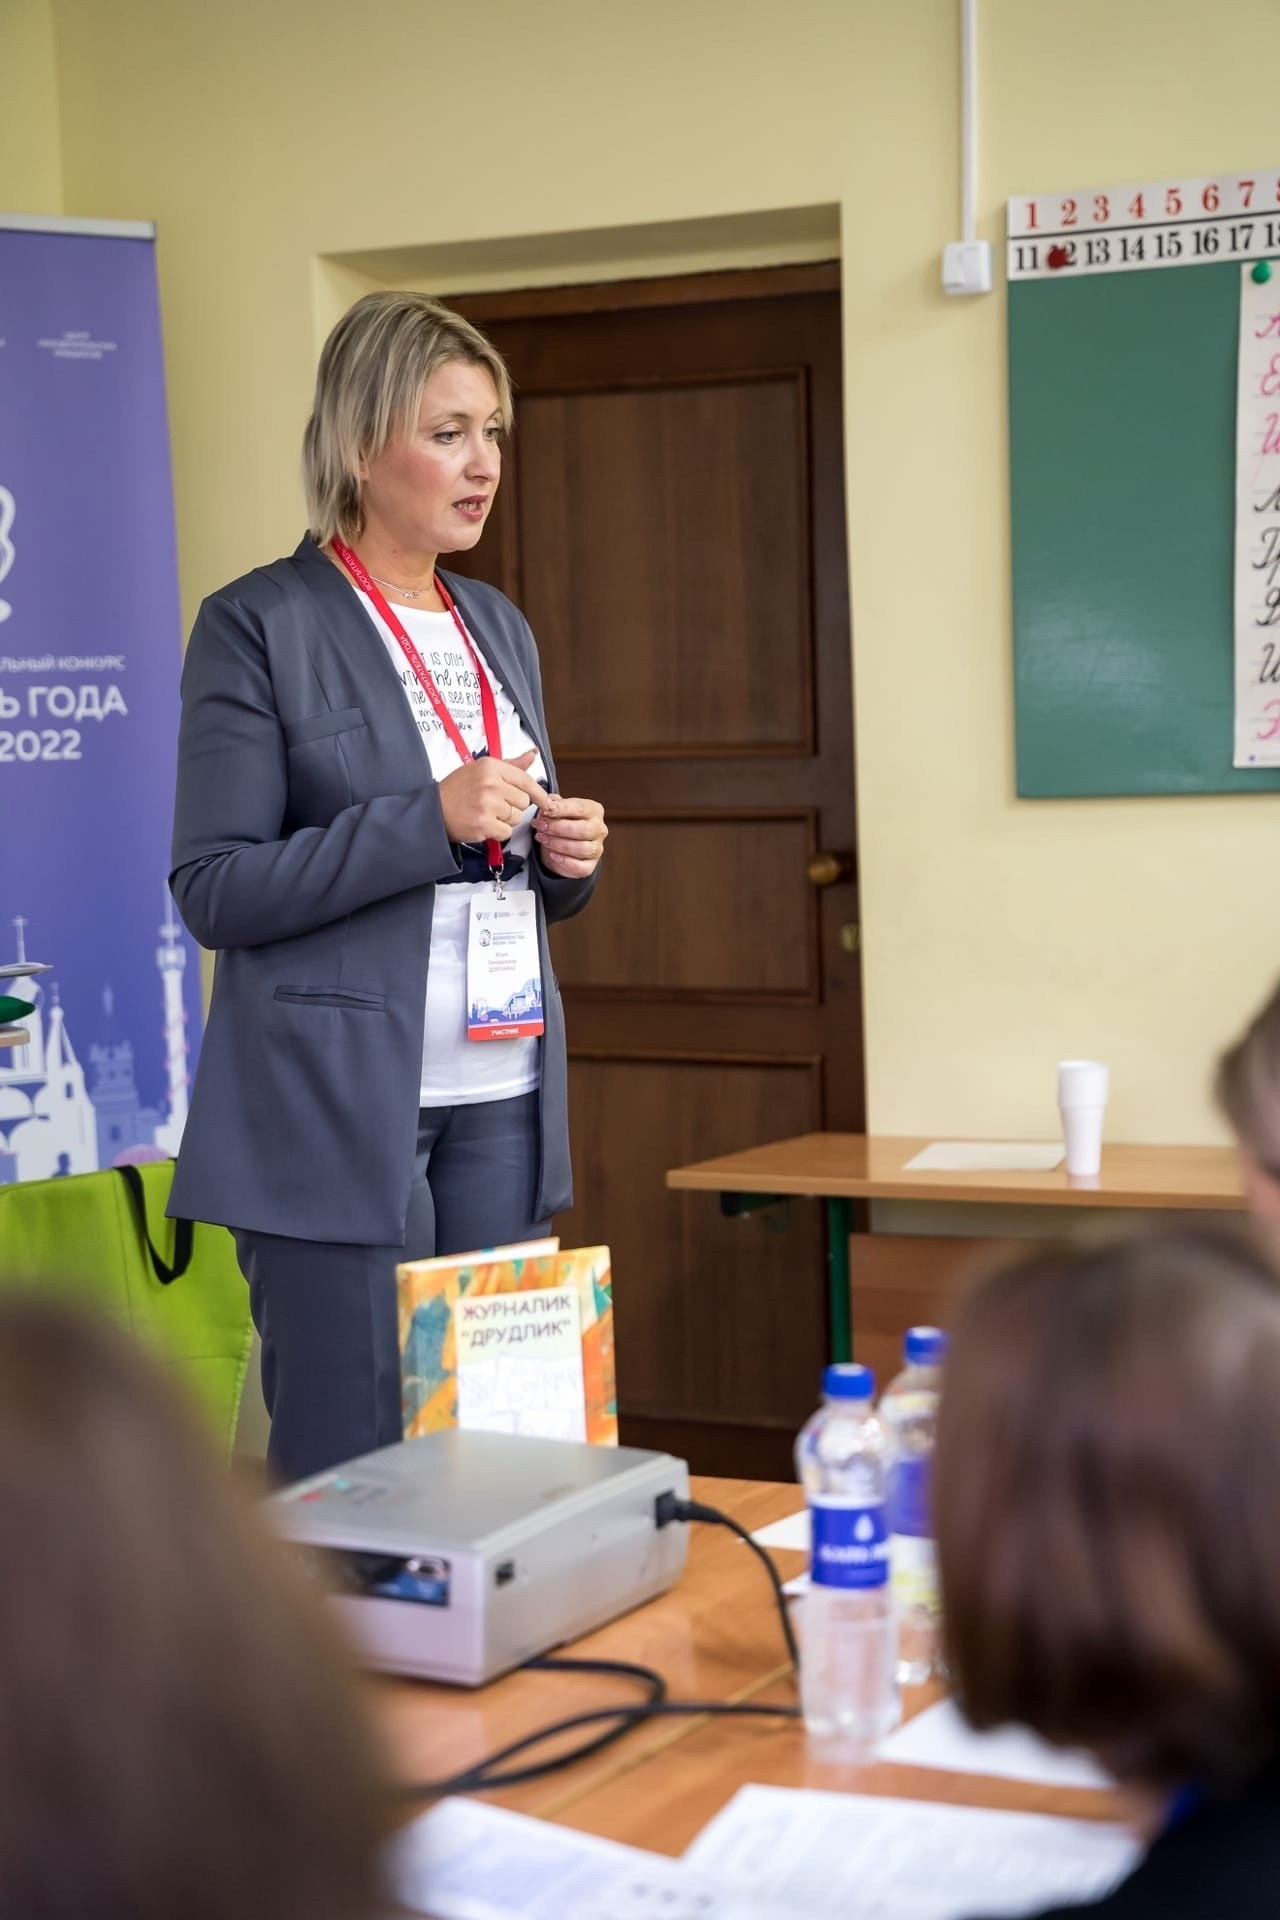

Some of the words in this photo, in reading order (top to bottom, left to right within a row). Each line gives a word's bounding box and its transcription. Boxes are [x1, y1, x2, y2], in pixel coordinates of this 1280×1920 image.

[1027, 202, 1037, 229] 1
[1061, 199, 1077, 226] 2
[1093, 194, 1110, 223] 3
[1128, 192, 1145, 219] 4
[1166, 188, 1182, 216] 5
[1202, 184, 1220, 213] 6
[1238, 180, 1255, 209] 7
[1016, 246, 1039, 271] 11
[1086, 238, 1110, 265] 13
[1119, 235, 1145, 262] 14
[1156, 231, 1182, 258] 15
[1193, 226, 1220, 255] 16
[1229, 223, 1254, 252] 17
[400, 634, 414, 653] ГОДА
[58, 655, 127, 672] КОНКУРС
[410, 652, 441, 705] ВОСПИТАТЕЛЬ
[28, 685, 128, 722] ГОДА
[0, 729, 82, 762] 2022
[463, 1295, 572, 1321] ЖУРНАЛИК
